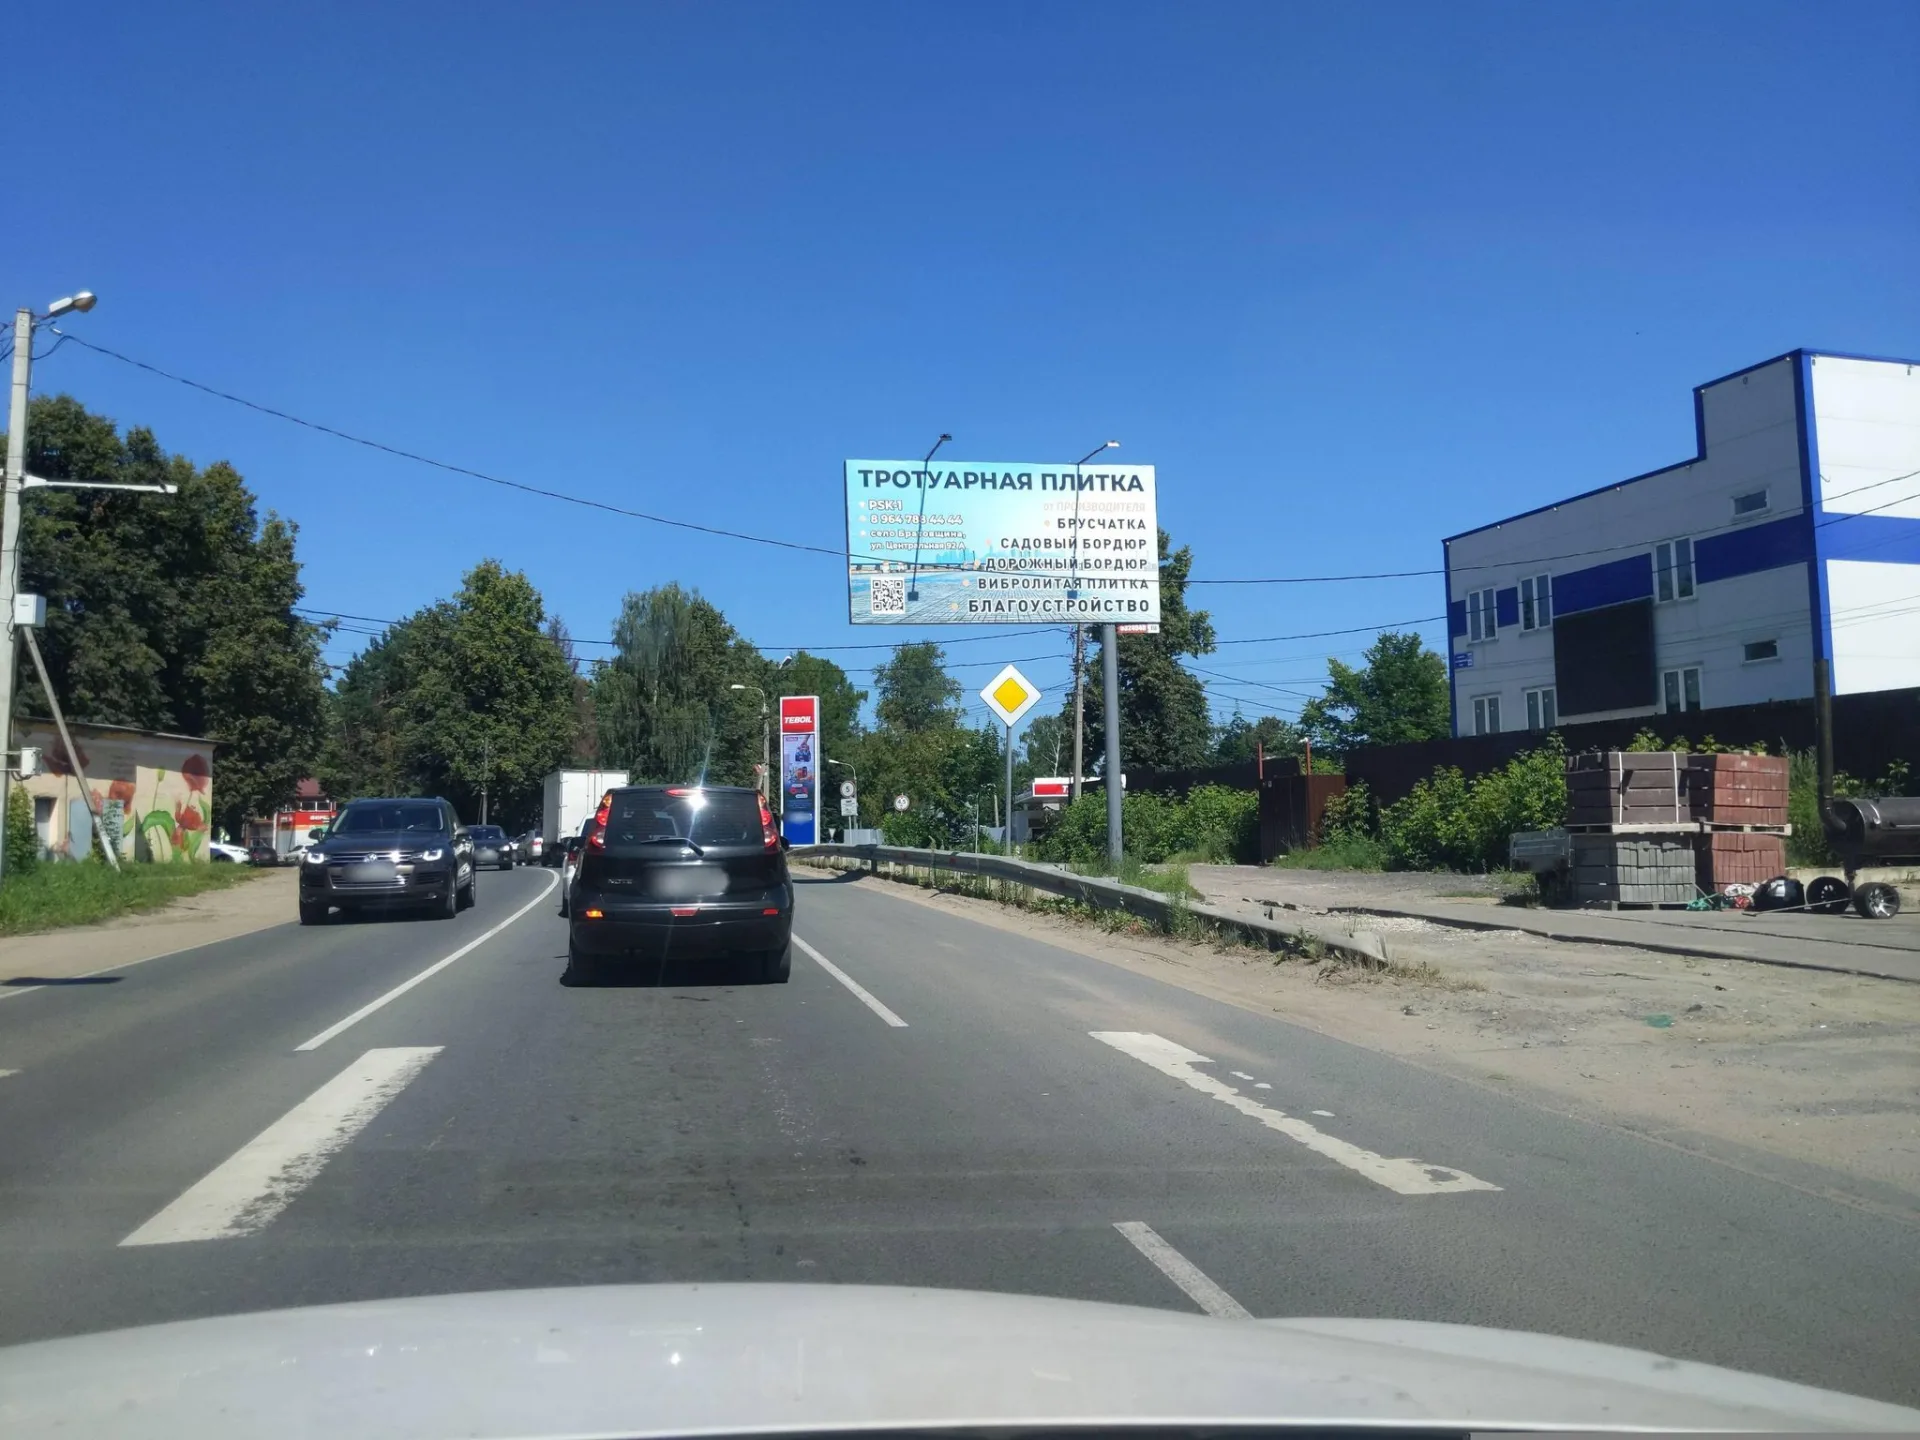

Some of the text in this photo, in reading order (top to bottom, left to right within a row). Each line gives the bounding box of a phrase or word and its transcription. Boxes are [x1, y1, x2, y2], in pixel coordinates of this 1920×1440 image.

[858, 470, 1144, 492] ТРОТУАРНАЯ ПЛИТКА
[868, 500, 903, 511] PSK-1
[1056, 502, 1146, 512] ПРОИЗВОДИТЕЛЯ
[870, 515, 878, 524] 8
[880, 515, 903, 524] 964
[929, 515, 945, 524] 44
[947, 515, 963, 524] 44
[1057, 518, 1146, 530] БРУСЧАТКА
[870, 530, 896, 538] село
[1000, 536, 1147, 551] САДОВЫЙ БОРДЮР
[985, 557, 1148, 571] ДОРОЖНЫЙ БОРДЮР
[978, 578, 1149, 590] ВИБРОЛИТАЯ ПЛИТКА
[968, 597, 1149, 613] БЛАГОУСТРОЙСТВО
[784, 716, 812, 724] TEBOIL
